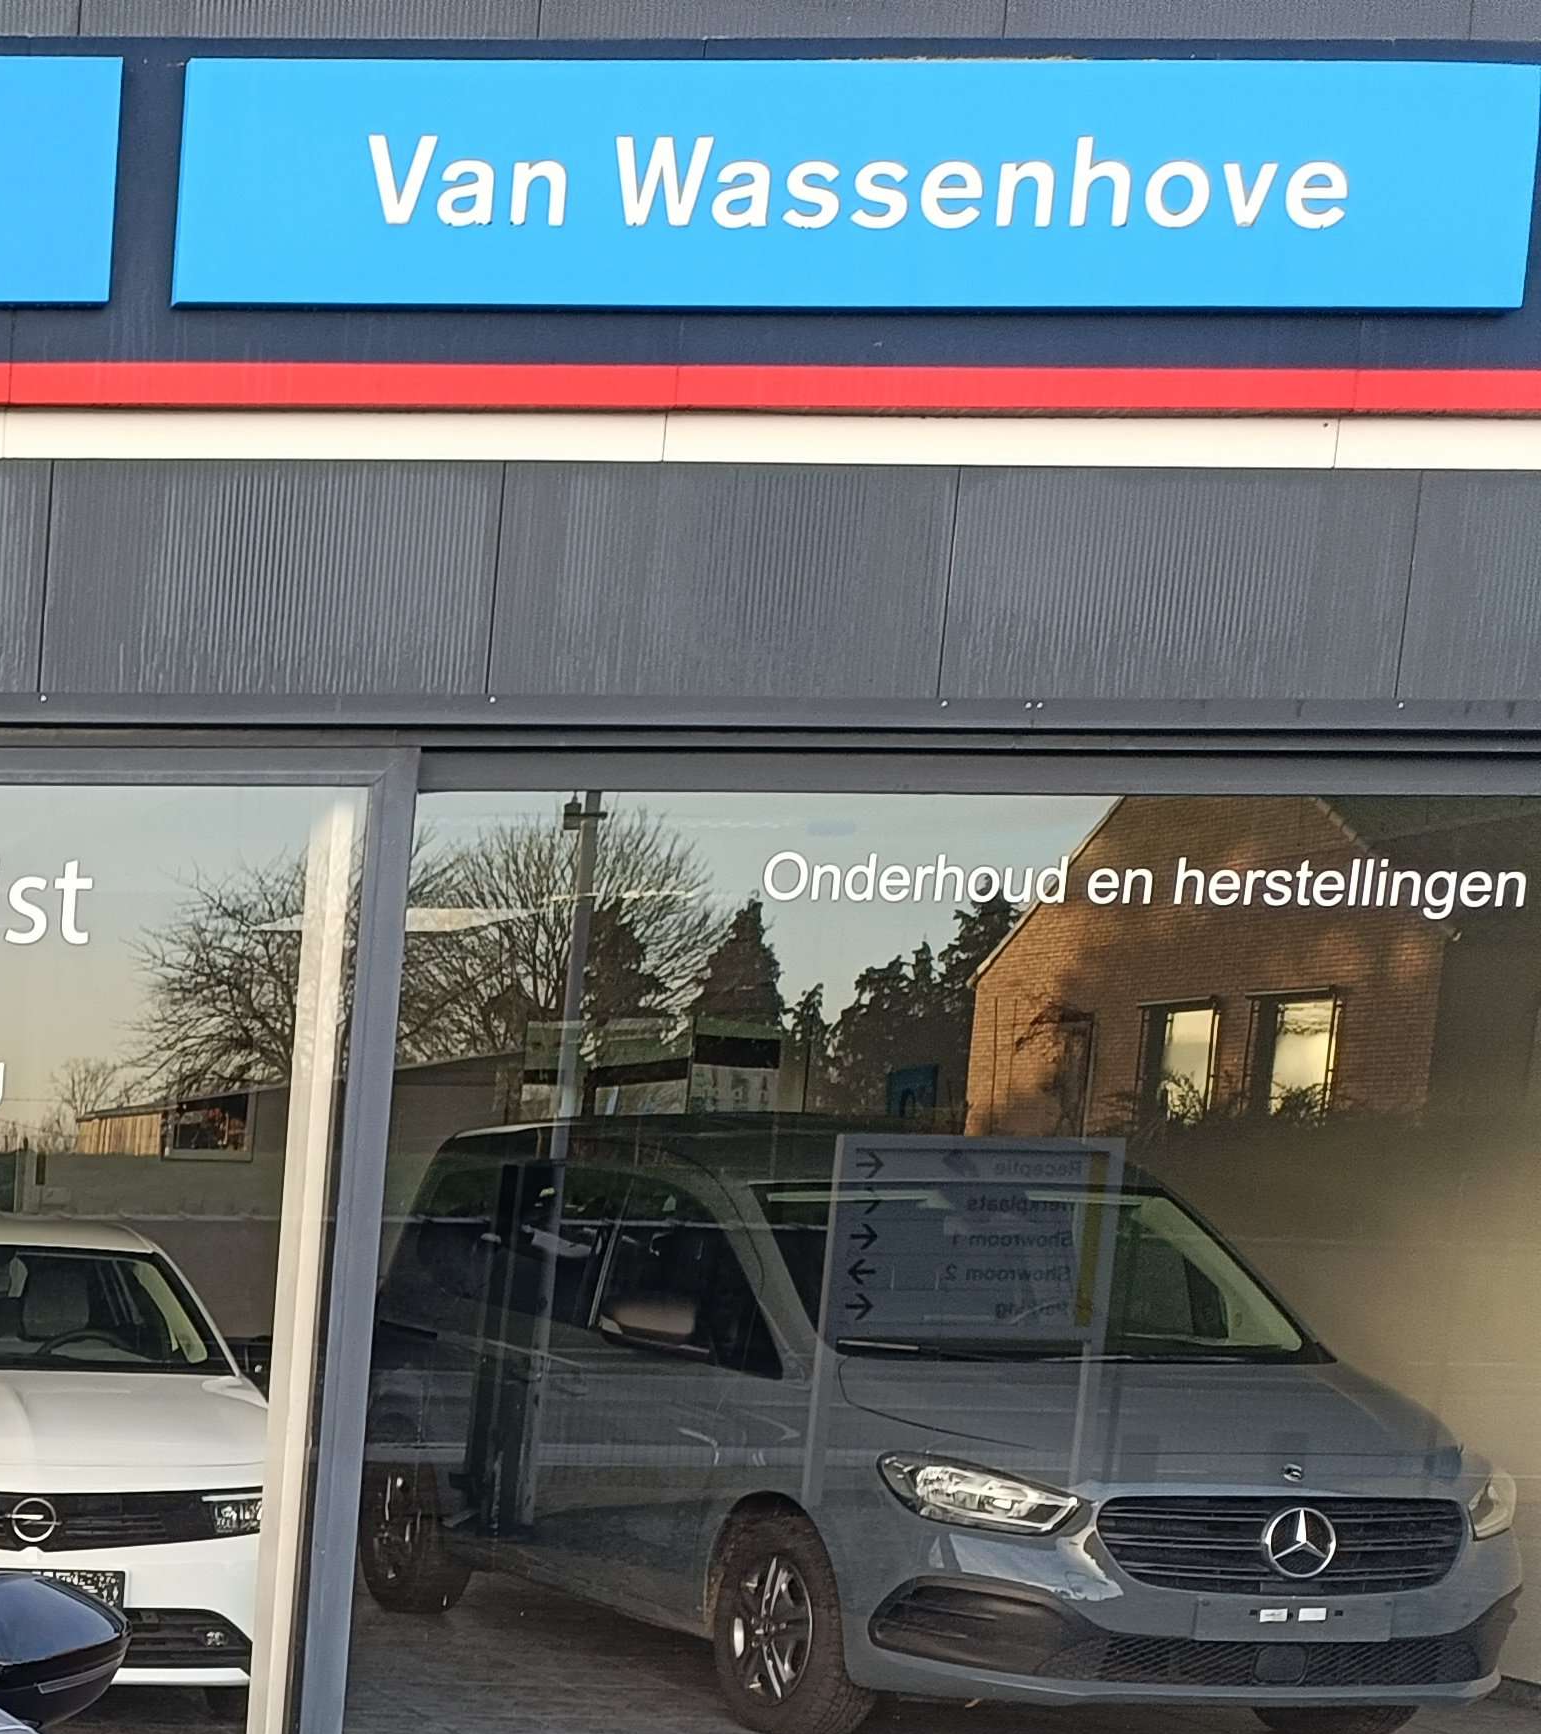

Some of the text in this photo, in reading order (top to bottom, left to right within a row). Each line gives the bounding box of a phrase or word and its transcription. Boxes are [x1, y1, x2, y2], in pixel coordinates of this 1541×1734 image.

[367, 133, 1348, 230] Van Wassenhove
[763, 851, 1527, 920] Onderhoud en herstellingen
